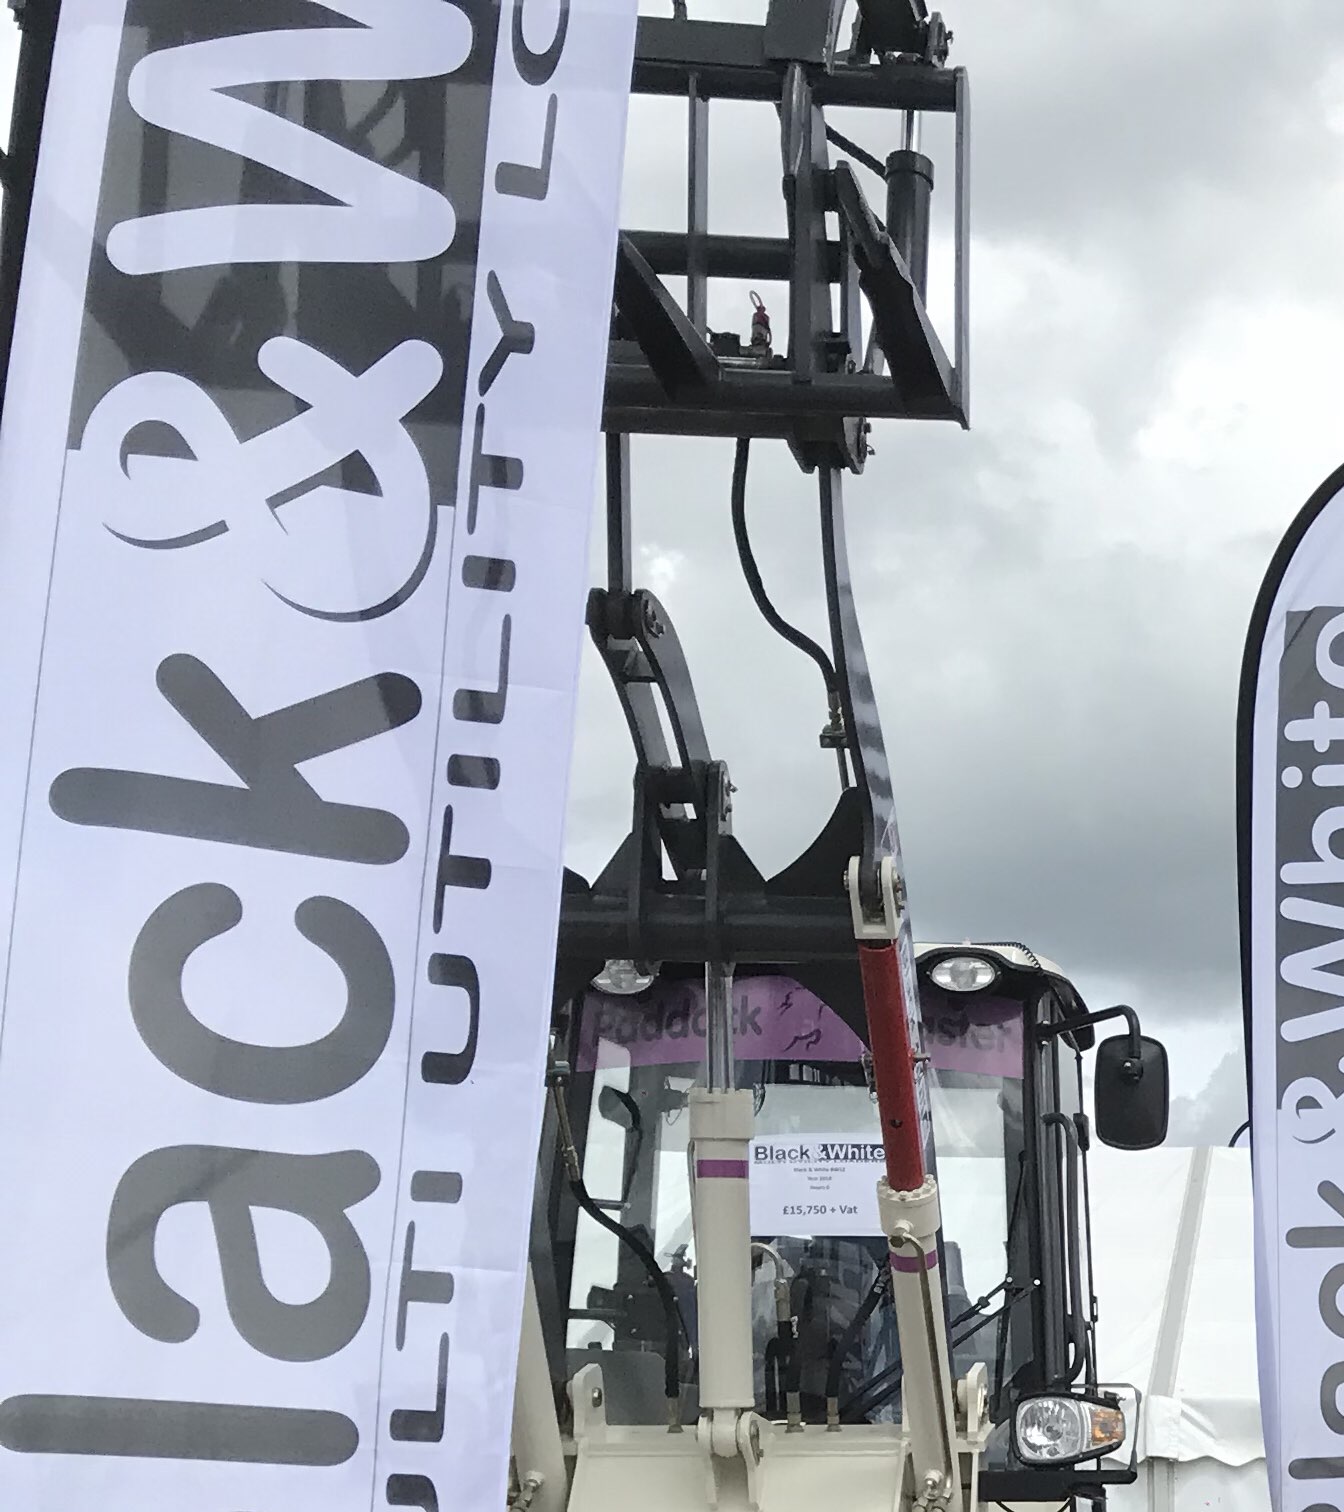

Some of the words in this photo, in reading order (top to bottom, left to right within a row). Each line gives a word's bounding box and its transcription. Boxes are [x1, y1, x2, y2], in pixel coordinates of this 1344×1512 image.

[421, 271, 536, 1085] UTILITY
[783, 1205, 826, 1216] £15,750
[840, 1205, 858, 1214] Vat
